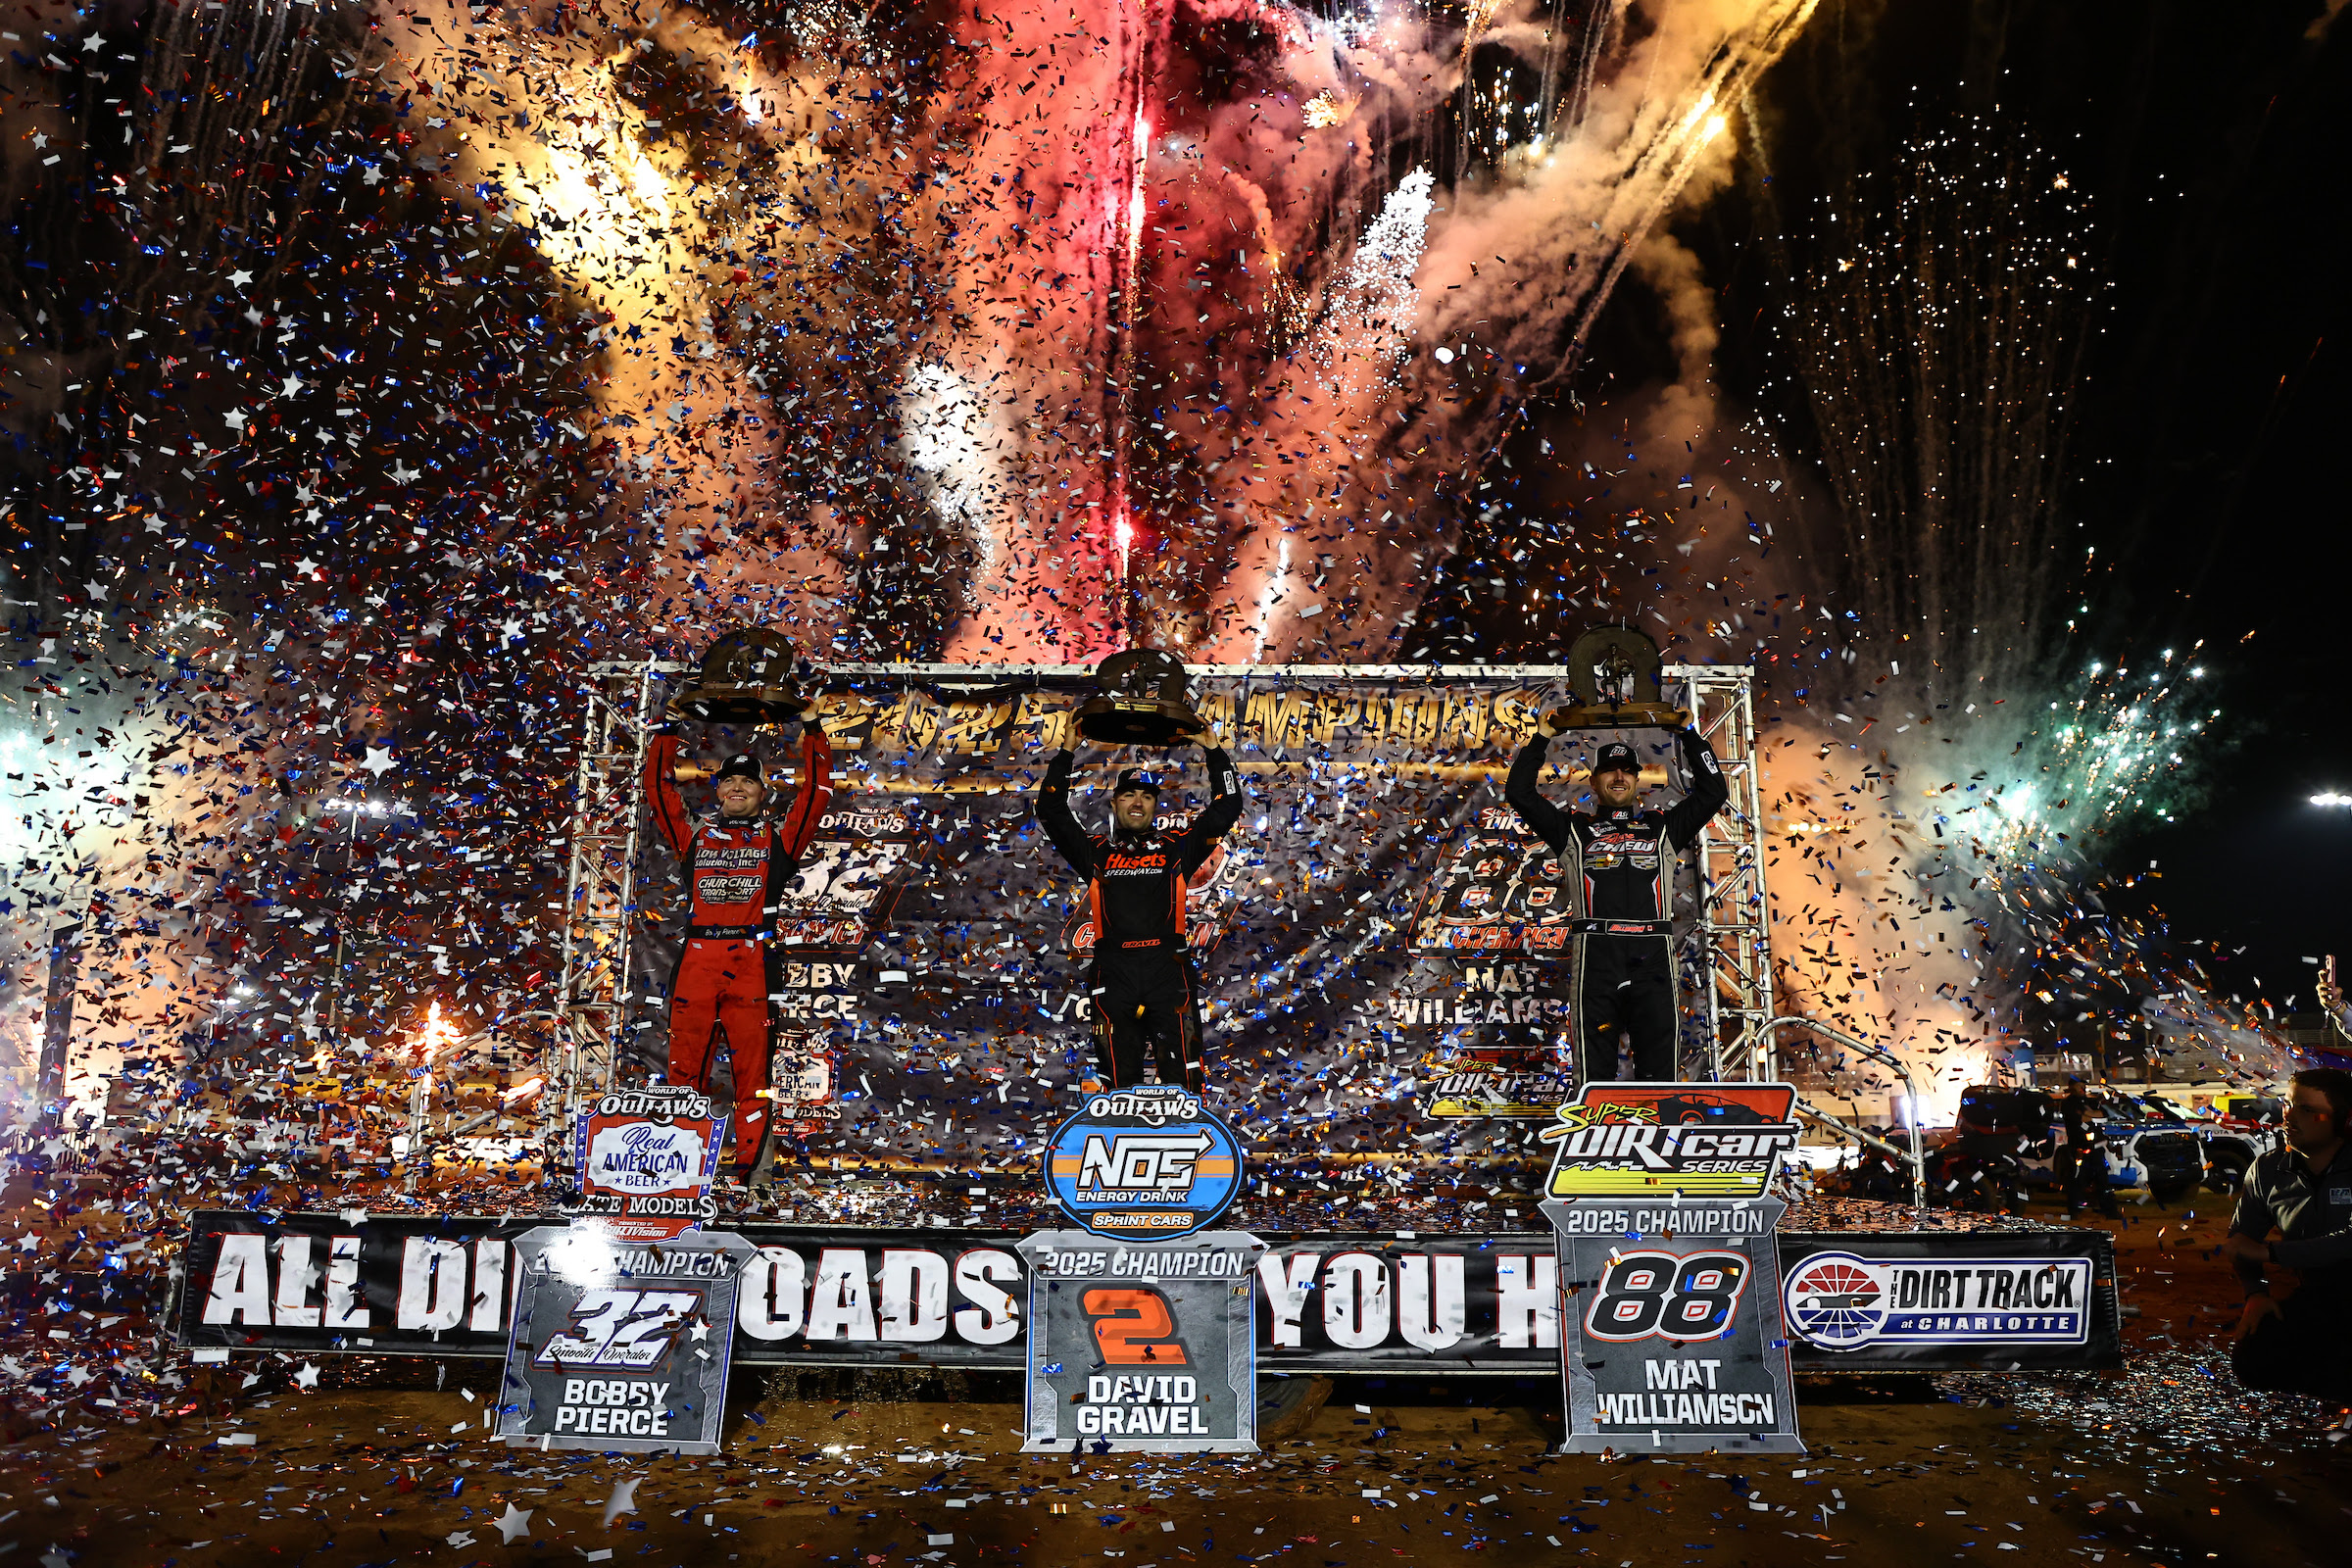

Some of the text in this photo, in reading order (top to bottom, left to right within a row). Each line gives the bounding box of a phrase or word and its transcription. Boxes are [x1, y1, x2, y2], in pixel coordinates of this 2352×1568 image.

[1588, 841, 1655, 853] CHEW
[699, 877, 762, 891] CHURCHILL
[782, 962, 857, 989] BBY
[1465, 966, 1541, 993] MAT
[1387, 998, 1571, 1025] WILLIAMS
[599, 1091, 709, 1124] OUTLAWS
[1089, 1093, 1199, 1126] OUTLAWS
[1537, 1102, 1663, 1140] SUPER
[621, 1126, 676, 1152] Real
[602, 1152, 689, 1174] AMERICAN
[1077, 1131, 1214, 1189] NOS
[1679, 1159, 1770, 1173] SERIES
[625, 1175, 660, 1188] BEER
[627, 1195, 717, 1218] MODELS
[1076, 1191, 1188, 1202] ENERGY DRINK
[1094, 1214, 1192, 1226] SPRINT CARS
[1568, 1208, 1764, 1234] 2025 CHAMPION
[613, 1250, 731, 1277] HAMPION
[1045, 1251, 1245, 1277] 2025 CHAMPION
[200, 1233, 370, 1329] ALL
[396, 1235, 508, 1333] DI
[738, 1244, 1021, 1346] OADS
[1257, 1250, 1466, 1350] YOU
[1585, 1250, 1751, 1342] 88
[1888, 1268, 2077, 1309] THE DIRT TRACK
[533, 1289, 703, 1368] 32
[1082, 1289, 1188, 1365] 2
[1900, 1316, 2070, 1331] at CHARLOTTE
[546, 1345, 653, 1361] Smooth Operator
[1644, 1359, 1722, 1391] MAT
[564, 1378, 670, 1407] BOBBY
[1088, 1375, 1197, 1403] DAVID
[554, 1405, 668, 1436] PIERCE
[1077, 1405, 1209, 1435] GRAVEL
[1596, 1393, 1775, 1425] WILLIAMSON
